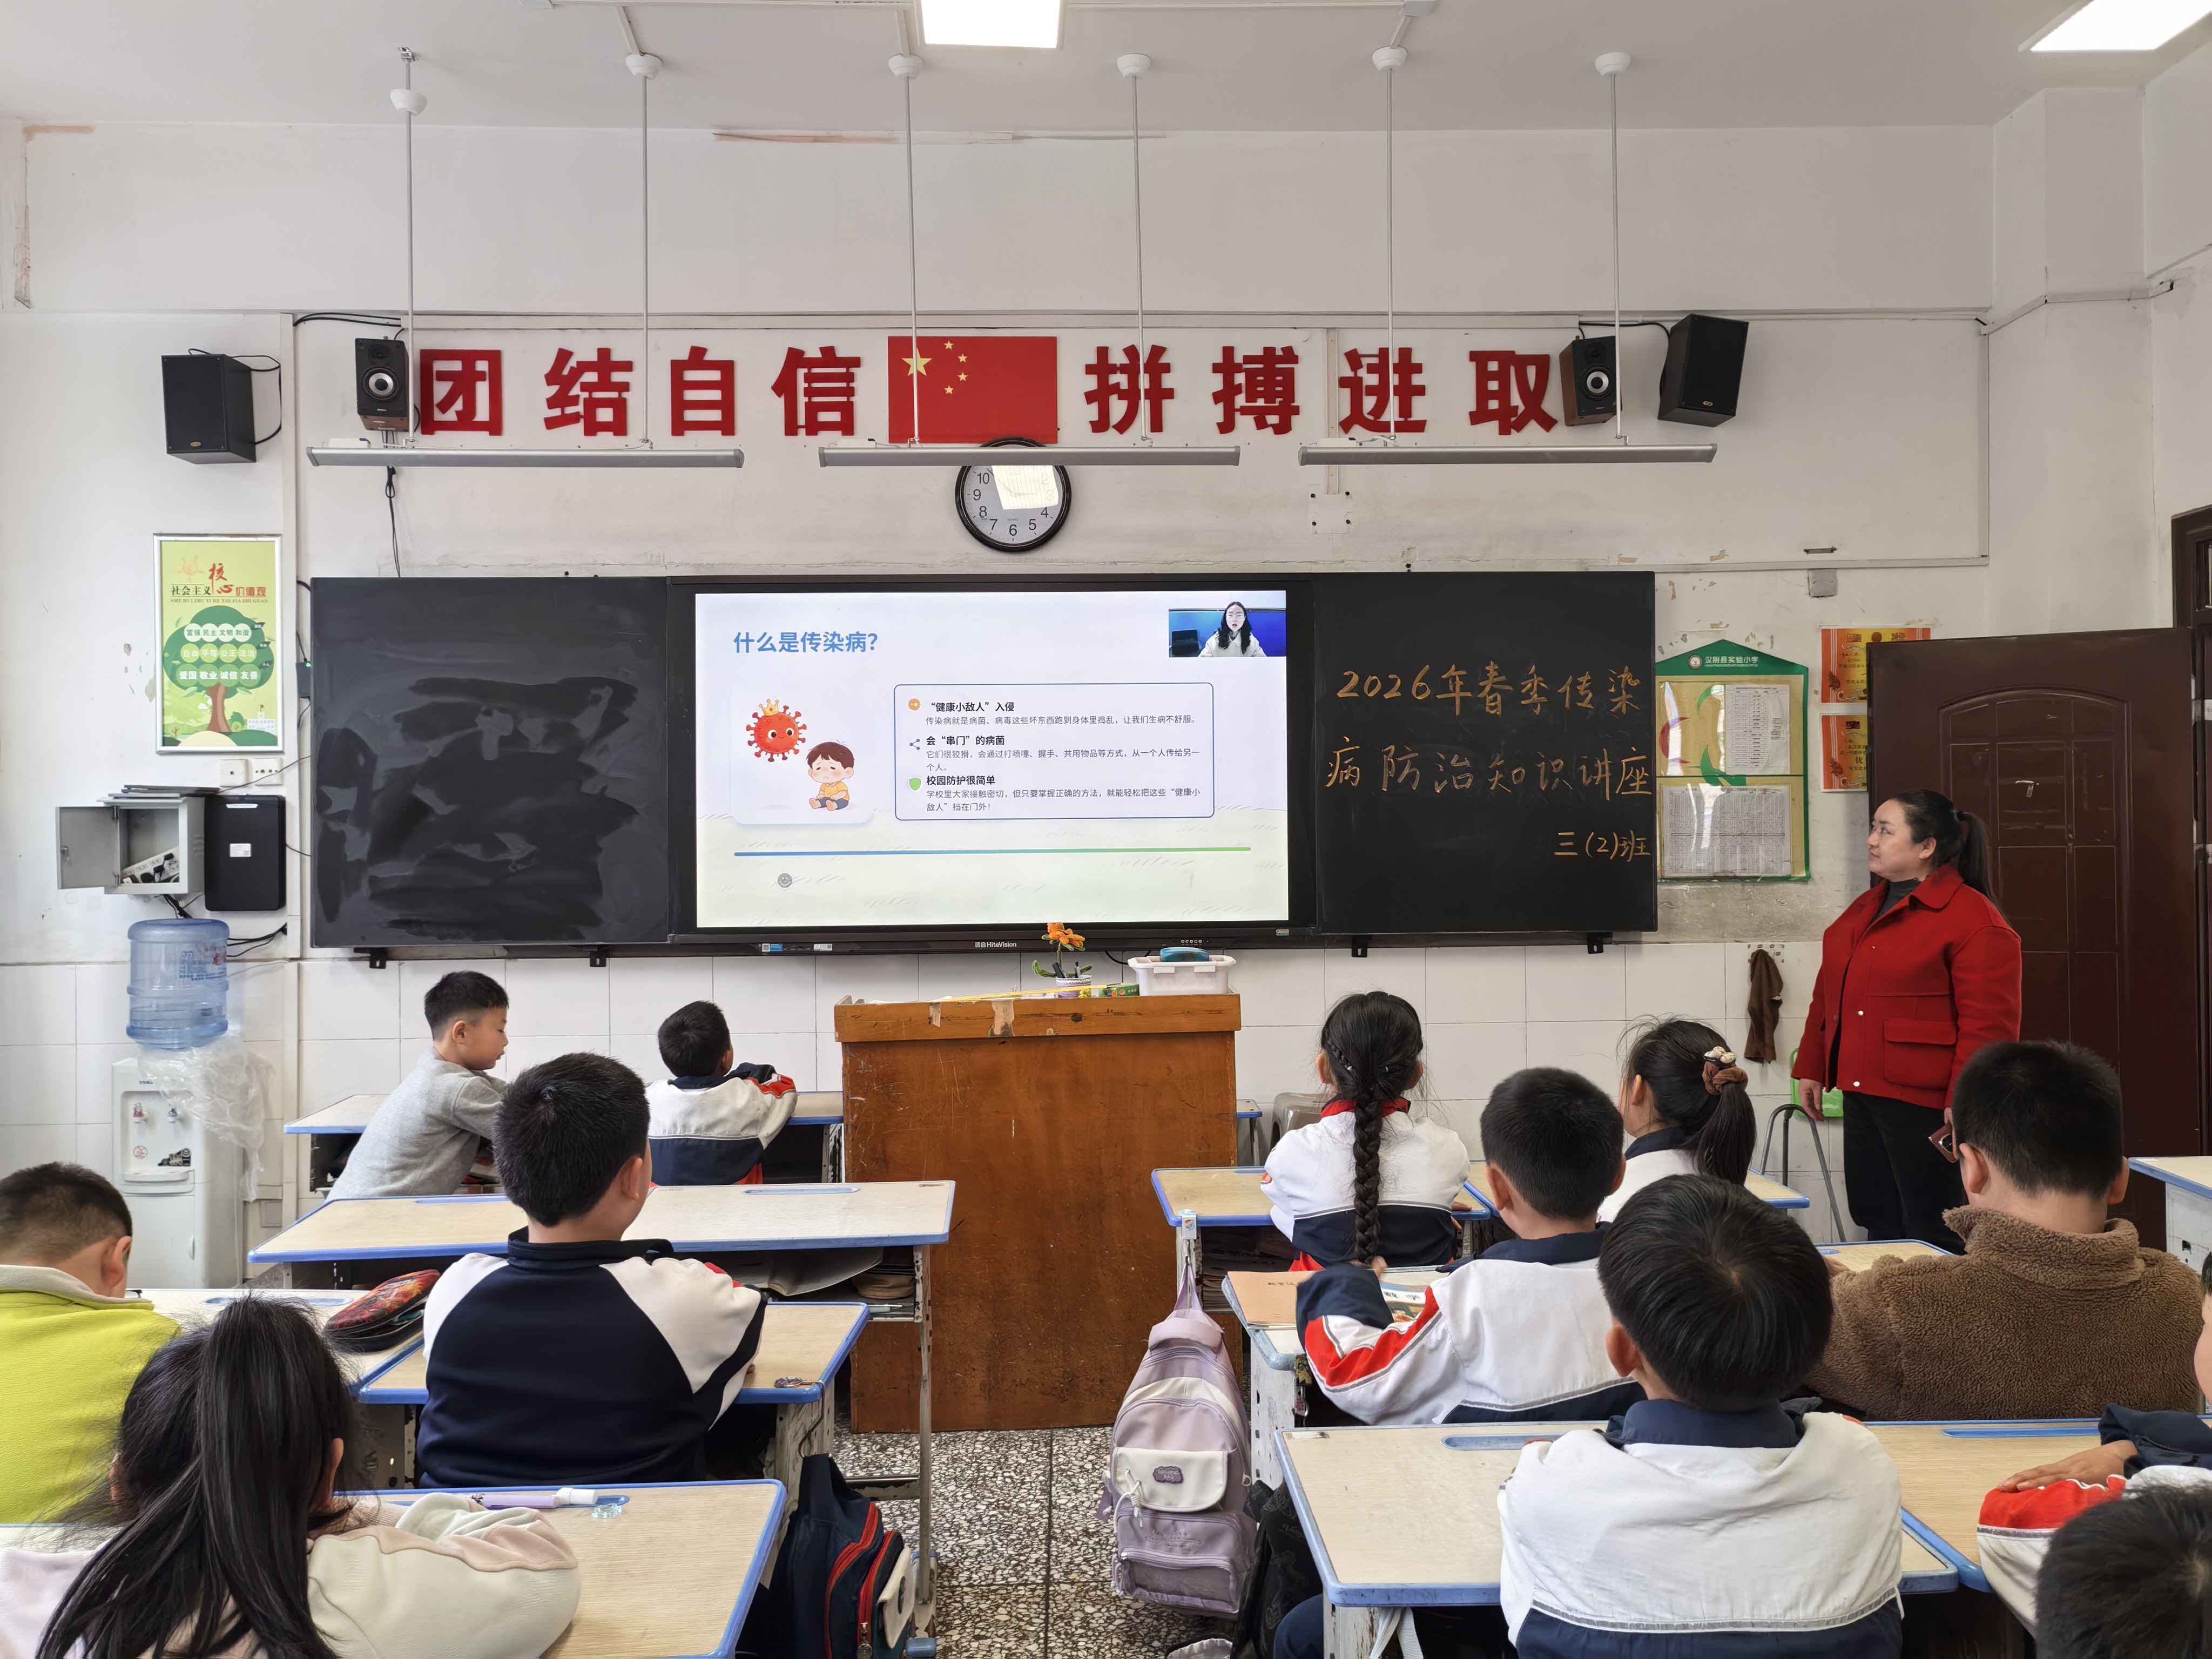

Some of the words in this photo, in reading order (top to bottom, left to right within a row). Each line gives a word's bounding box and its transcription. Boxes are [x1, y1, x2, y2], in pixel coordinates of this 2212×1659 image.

[420, 345, 861, 436] 团结自信
[1085, 344, 1557, 435] 拼搏进取
[977, 473, 989, 484] 10
[973, 489, 981, 501] 9
[979, 506, 987, 517] 8
[1041, 507, 1049, 518] 4
[990, 519, 998, 530] 7
[1009, 524, 1017, 536] 6
[1028, 519, 1036, 530] 5
[172, 585, 211, 595] 社会主义
[733, 631, 878, 654] 什么是传染病？
[1705, 656, 1759, 664] 汉阴县实验小学
[179, 671, 197, 680] 爱国
[200, 671, 218, 680] 敬业
[220, 671, 238, 680] 诚信
[240, 671, 258, 680] 友善
[1336, 660, 1641, 716] 2026年春季传染
[926, 763, 947, 772] 个人。
[1324, 736, 1653, 801] 病防治知识讲座
[926, 775, 995, 785] 校园防护很简单
